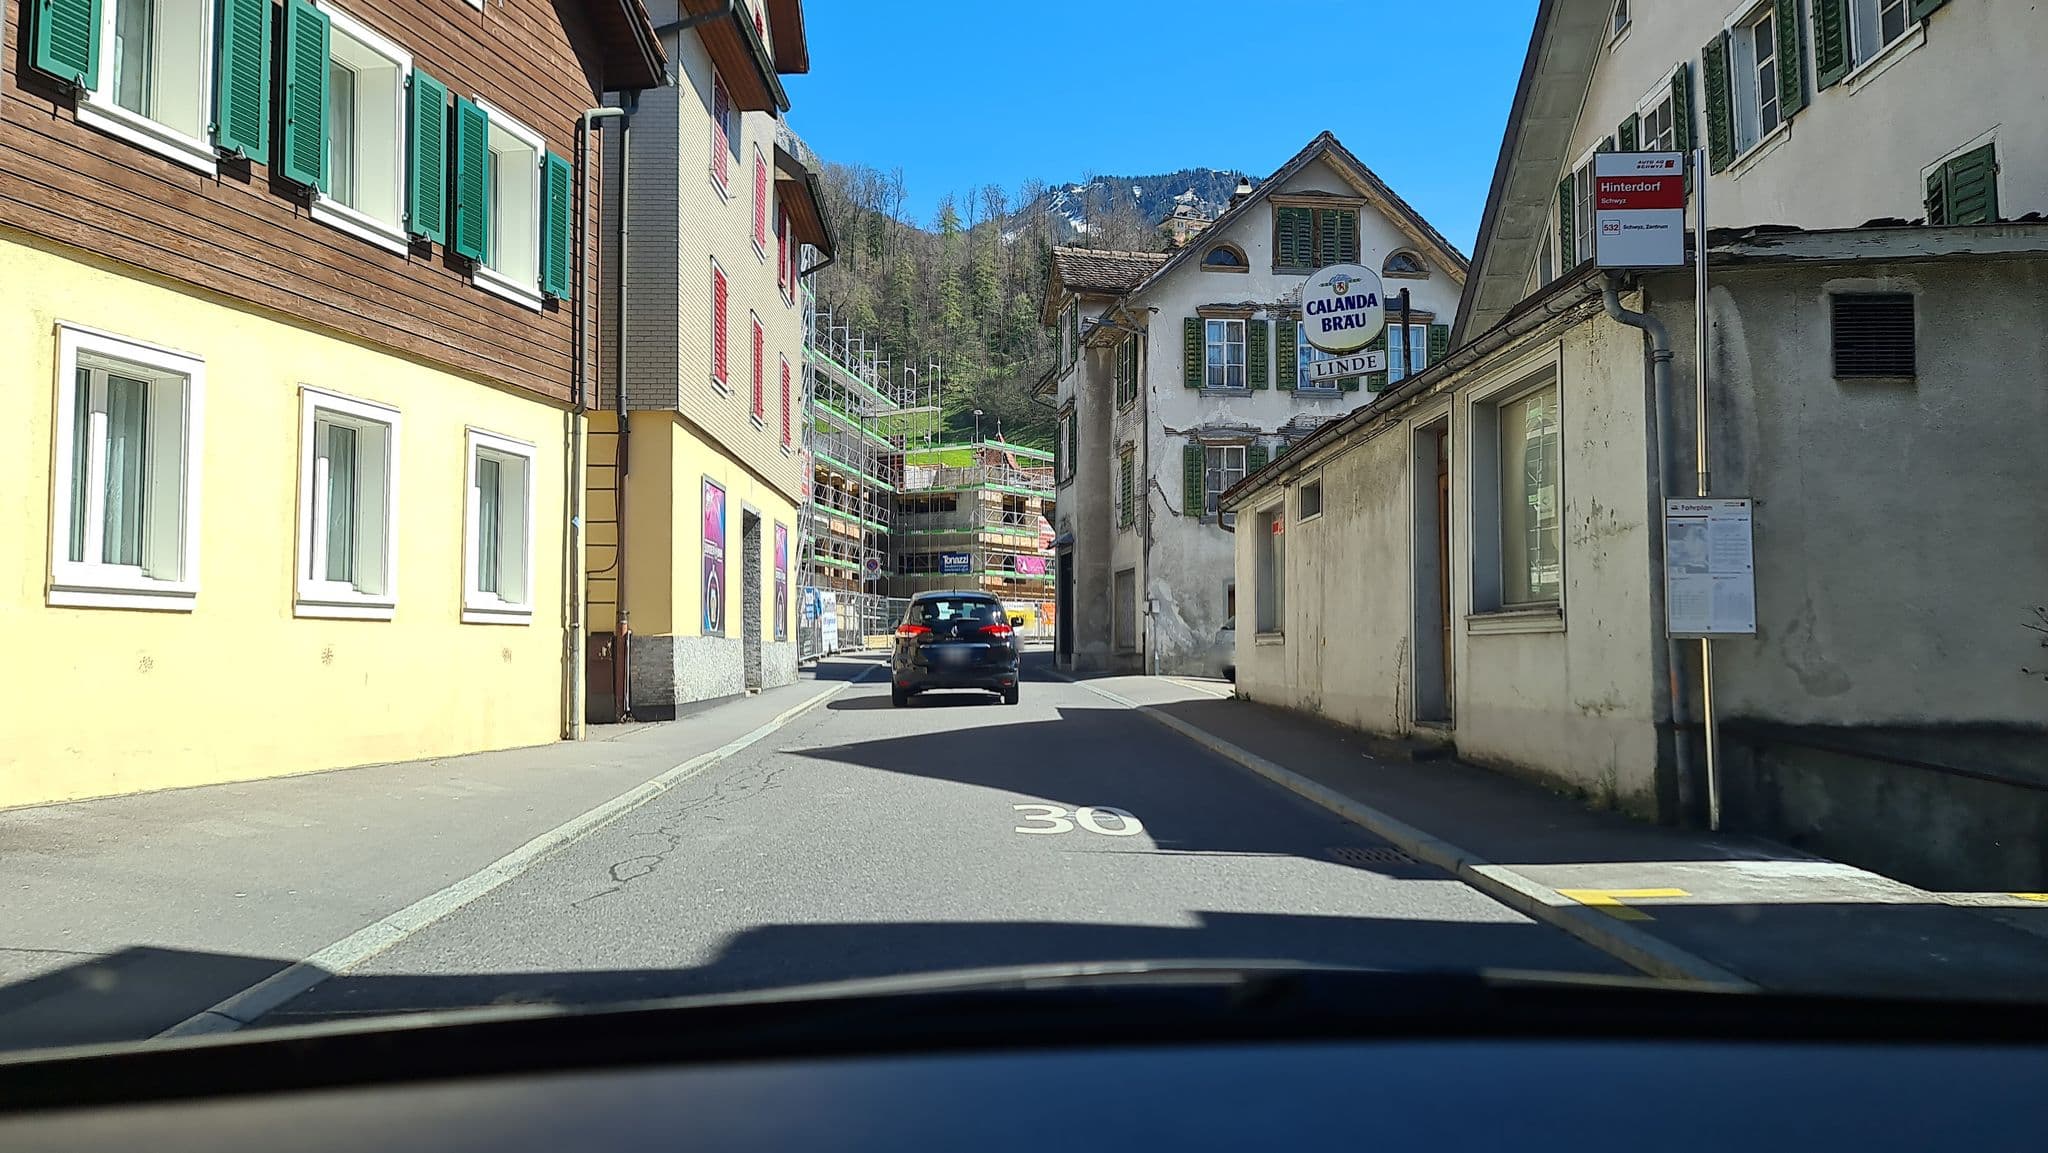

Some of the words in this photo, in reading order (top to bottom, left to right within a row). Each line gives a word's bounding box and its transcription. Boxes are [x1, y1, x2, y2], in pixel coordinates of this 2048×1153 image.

[1601, 182, 1661, 192] Hinterdorf
[1603, 223, 1619, 232] 532
[1306, 292, 1379, 317] CALANDA
[1321, 312, 1367, 333] BRÄU
[1315, 355, 1378, 377] LINDE
[1680, 504, 1713, 512] Fahrplan
[1012, 803, 1145, 837] 30
